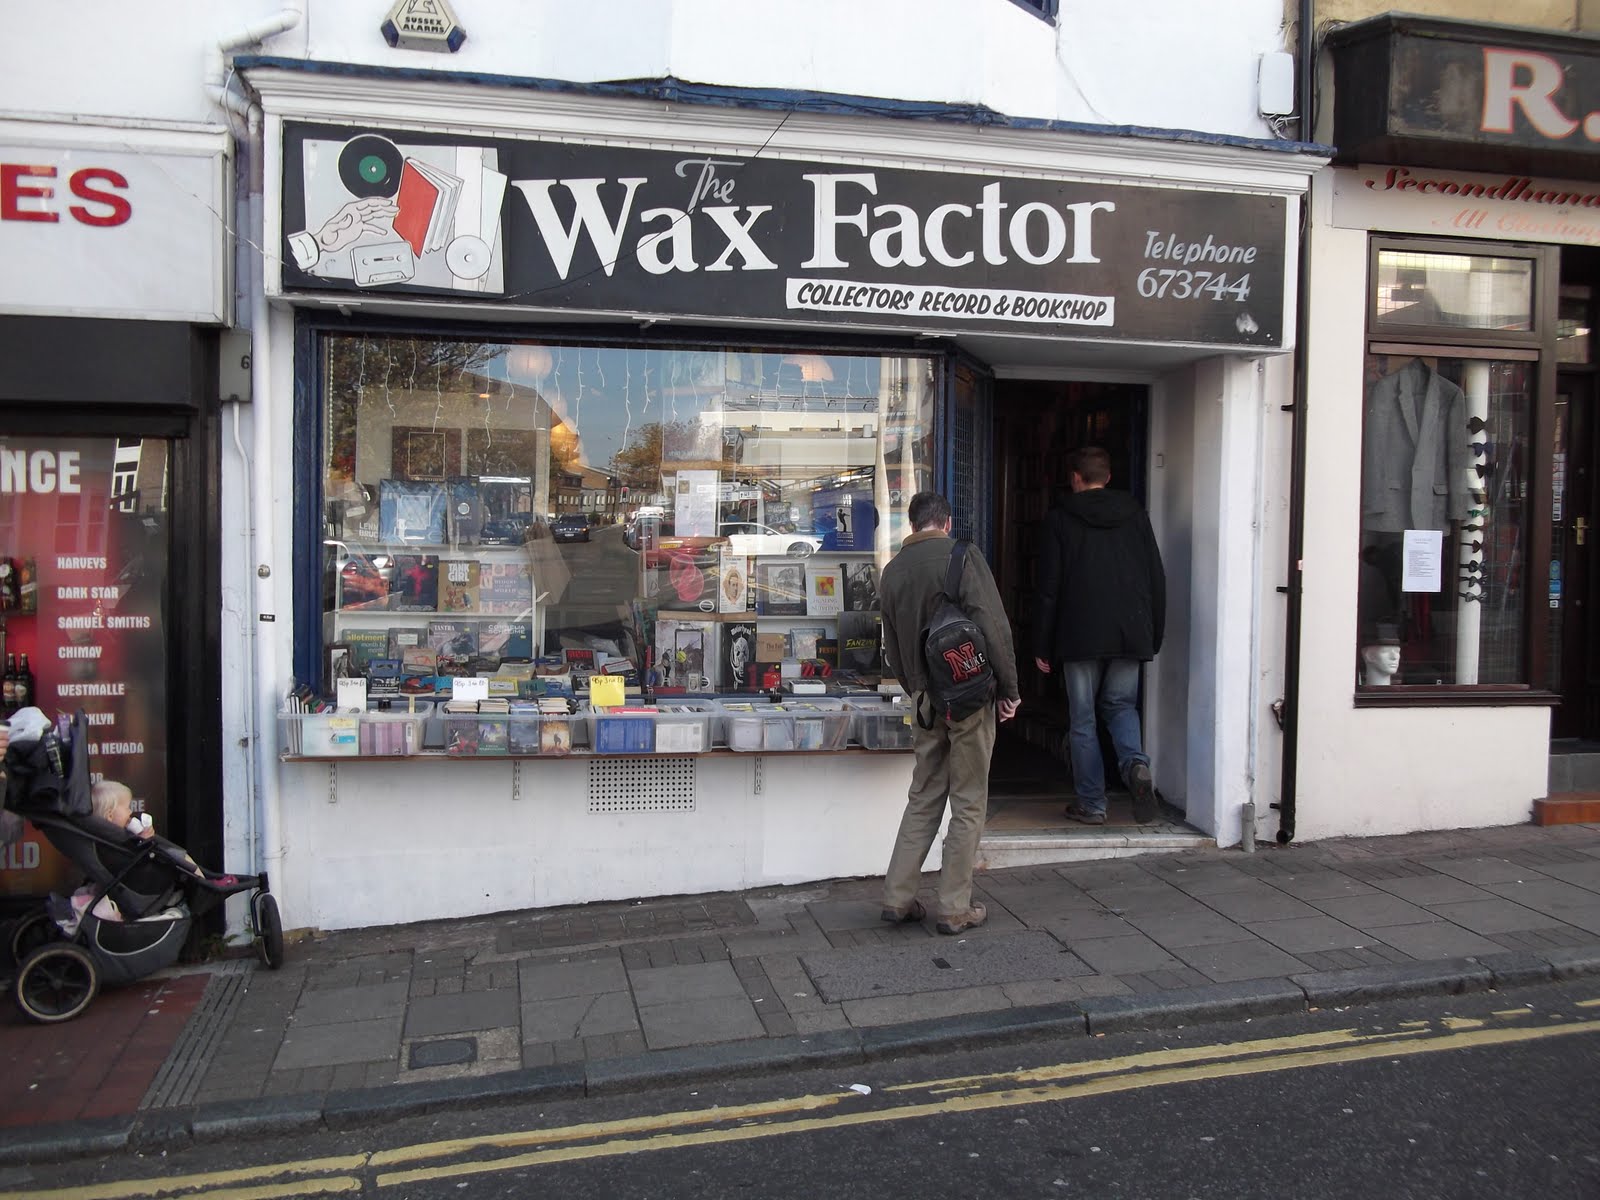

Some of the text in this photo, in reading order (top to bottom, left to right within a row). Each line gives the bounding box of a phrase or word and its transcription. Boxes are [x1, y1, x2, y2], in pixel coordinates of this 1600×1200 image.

[405, 16, 442, 25] SUSSEX
[403, 23, 444, 33] ALARMS
[674, 157, 746, 215] The
[510, 172, 1116, 280] Wax Factor
[1144, 230, 1257, 266] Telephone
[1137, 267, 1251, 302] 673744
[797, 282, 1107, 321] COLLECTORS RECORD & BOOKSHOP
[241, 354, 250, 370] 6
[57, 557, 107, 569] HARVEYS
[448, 563, 470, 573] TANK
[447, 572, 470, 582] GIRL
[57, 587, 119, 599] DARK STAR
[57, 617, 150, 629] SAMUEL SMITHS
[58, 646, 102, 659] CHIMAY
[962, 653, 986, 671] NIKE
[57, 683, 125, 696] WESTMALLE
[102, 742, 145, 755] NEVADA
